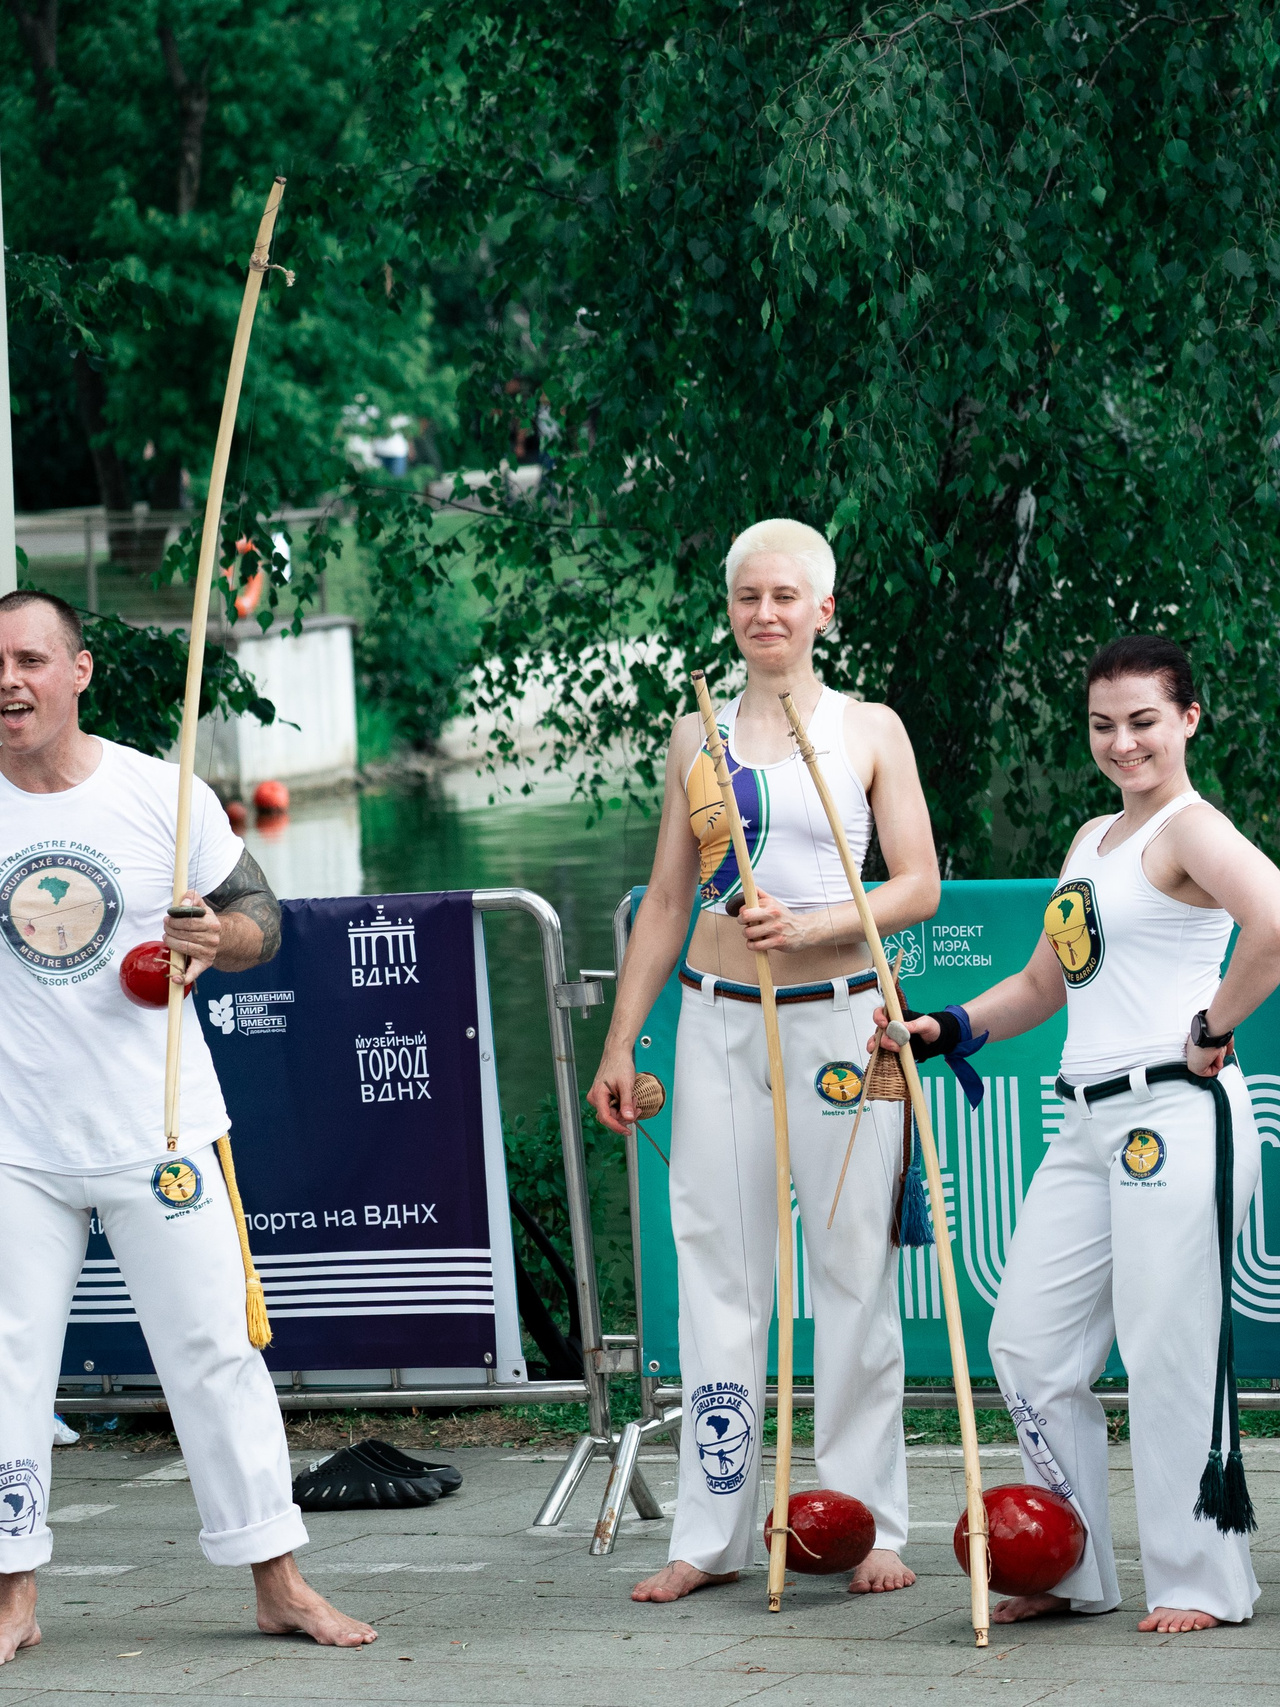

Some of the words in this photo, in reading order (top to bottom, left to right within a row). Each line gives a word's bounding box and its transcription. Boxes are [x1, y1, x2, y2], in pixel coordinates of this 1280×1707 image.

[70, 841, 121, 875] PARAFUSO
[0, 868, 28, 900] GRUPO
[31, 856, 53, 870] AXÉ
[57, 857, 108, 889] CAPOEIRA
[932, 925, 984, 937] ПРОЕКТ
[19, 945, 62, 968] MESTRE
[66, 933, 105, 967] BARRÃO
[932, 940, 970, 952] МЭРА
[71, 947, 115, 984] CIBORGUE
[933, 955, 992, 966] МОСКВЫ
[1075, 957, 1096, 981] BARRÃO
[351, 965, 420, 987] ВДНХ
[238, 993, 292, 1003] ИЗМЕНИМ
[239, 1006, 264, 1015] МИР
[240, 1017, 283, 1027] ВМЕСТЕ
[356, 1046, 430, 1082] ГОРОД
[360, 1080, 432, 1103] ВДНХ
[848, 1106, 871, 1115] Baão
[165, 1209, 191, 1221] Mestre
[243, 1207, 318, 1234] порта
[324, 1208, 357, 1227] на
[364, 1203, 439, 1230] ВДНХ
[716, 1381, 749, 1398] BARRÃO
[696, 1396, 724, 1414] GRUPO
[727, 1396, 742, 1410] AXÉ
[705, 1472, 745, 1491] CAPOEIRA
